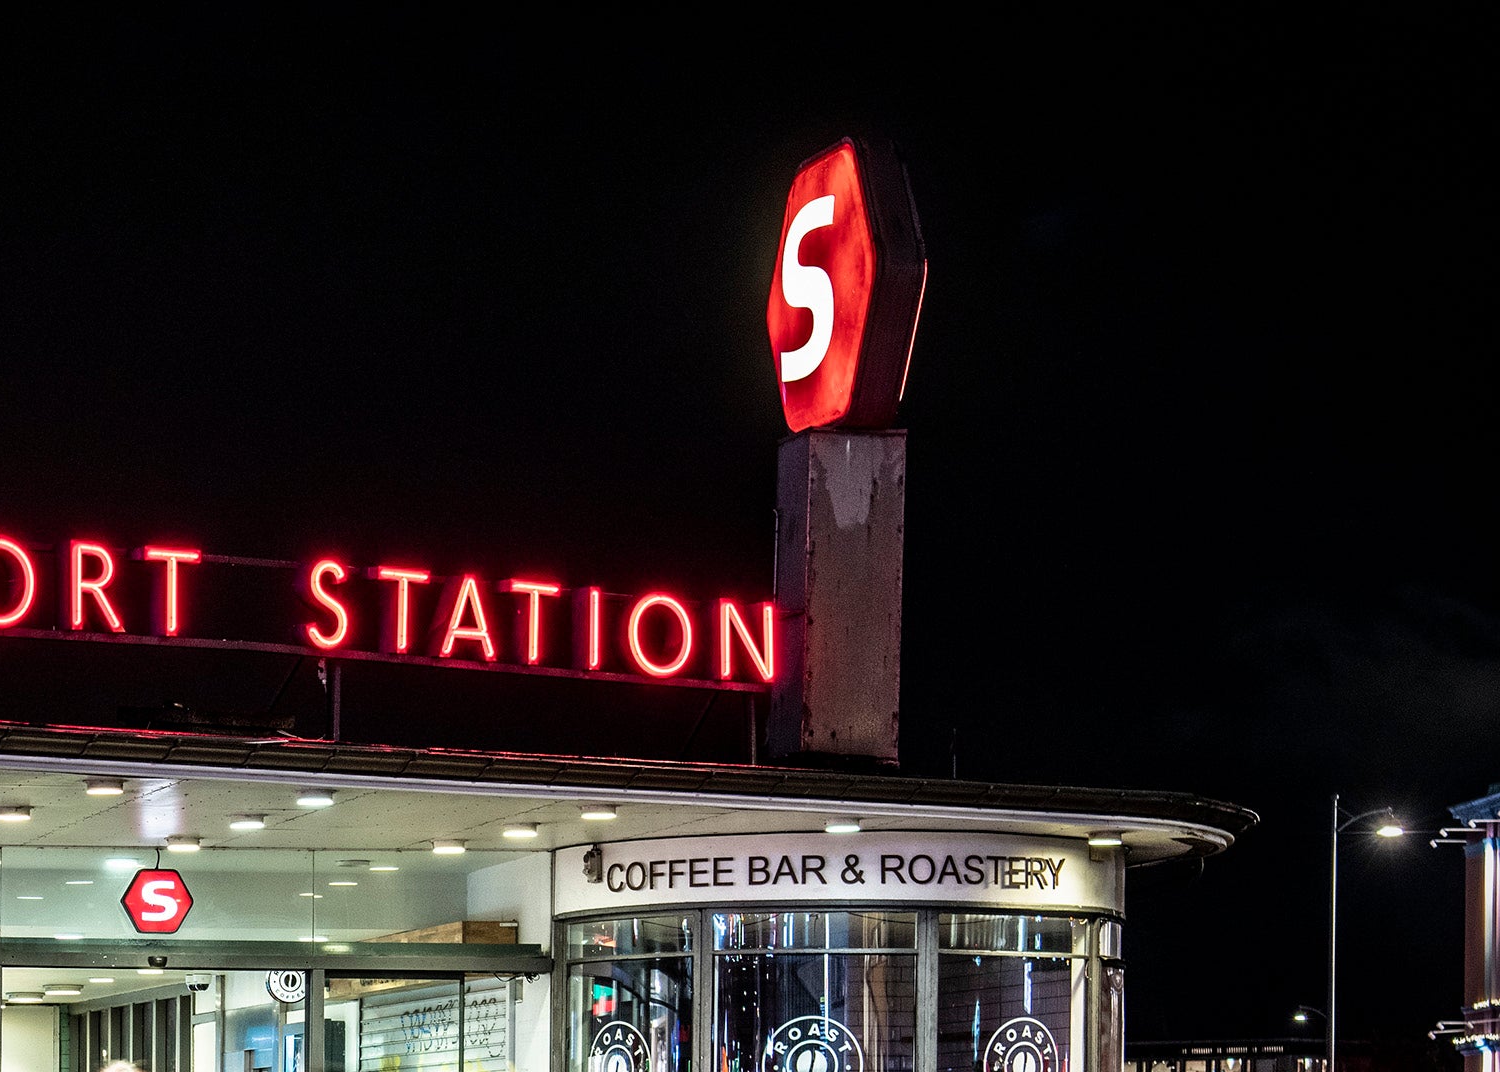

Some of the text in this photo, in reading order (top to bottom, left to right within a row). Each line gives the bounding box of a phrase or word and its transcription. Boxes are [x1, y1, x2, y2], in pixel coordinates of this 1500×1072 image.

[780, 194, 836, 383] S
[306, 558, 776, 682] STATION
[606, 853, 1066, 893] COFFEE BAR & ROASTERY
[141, 880, 179, 922] S
[594, 1028, 644, 1057] ROAST
[774, 1023, 852, 1055] ROAST
[993, 1025, 1052, 1056] ROAST
